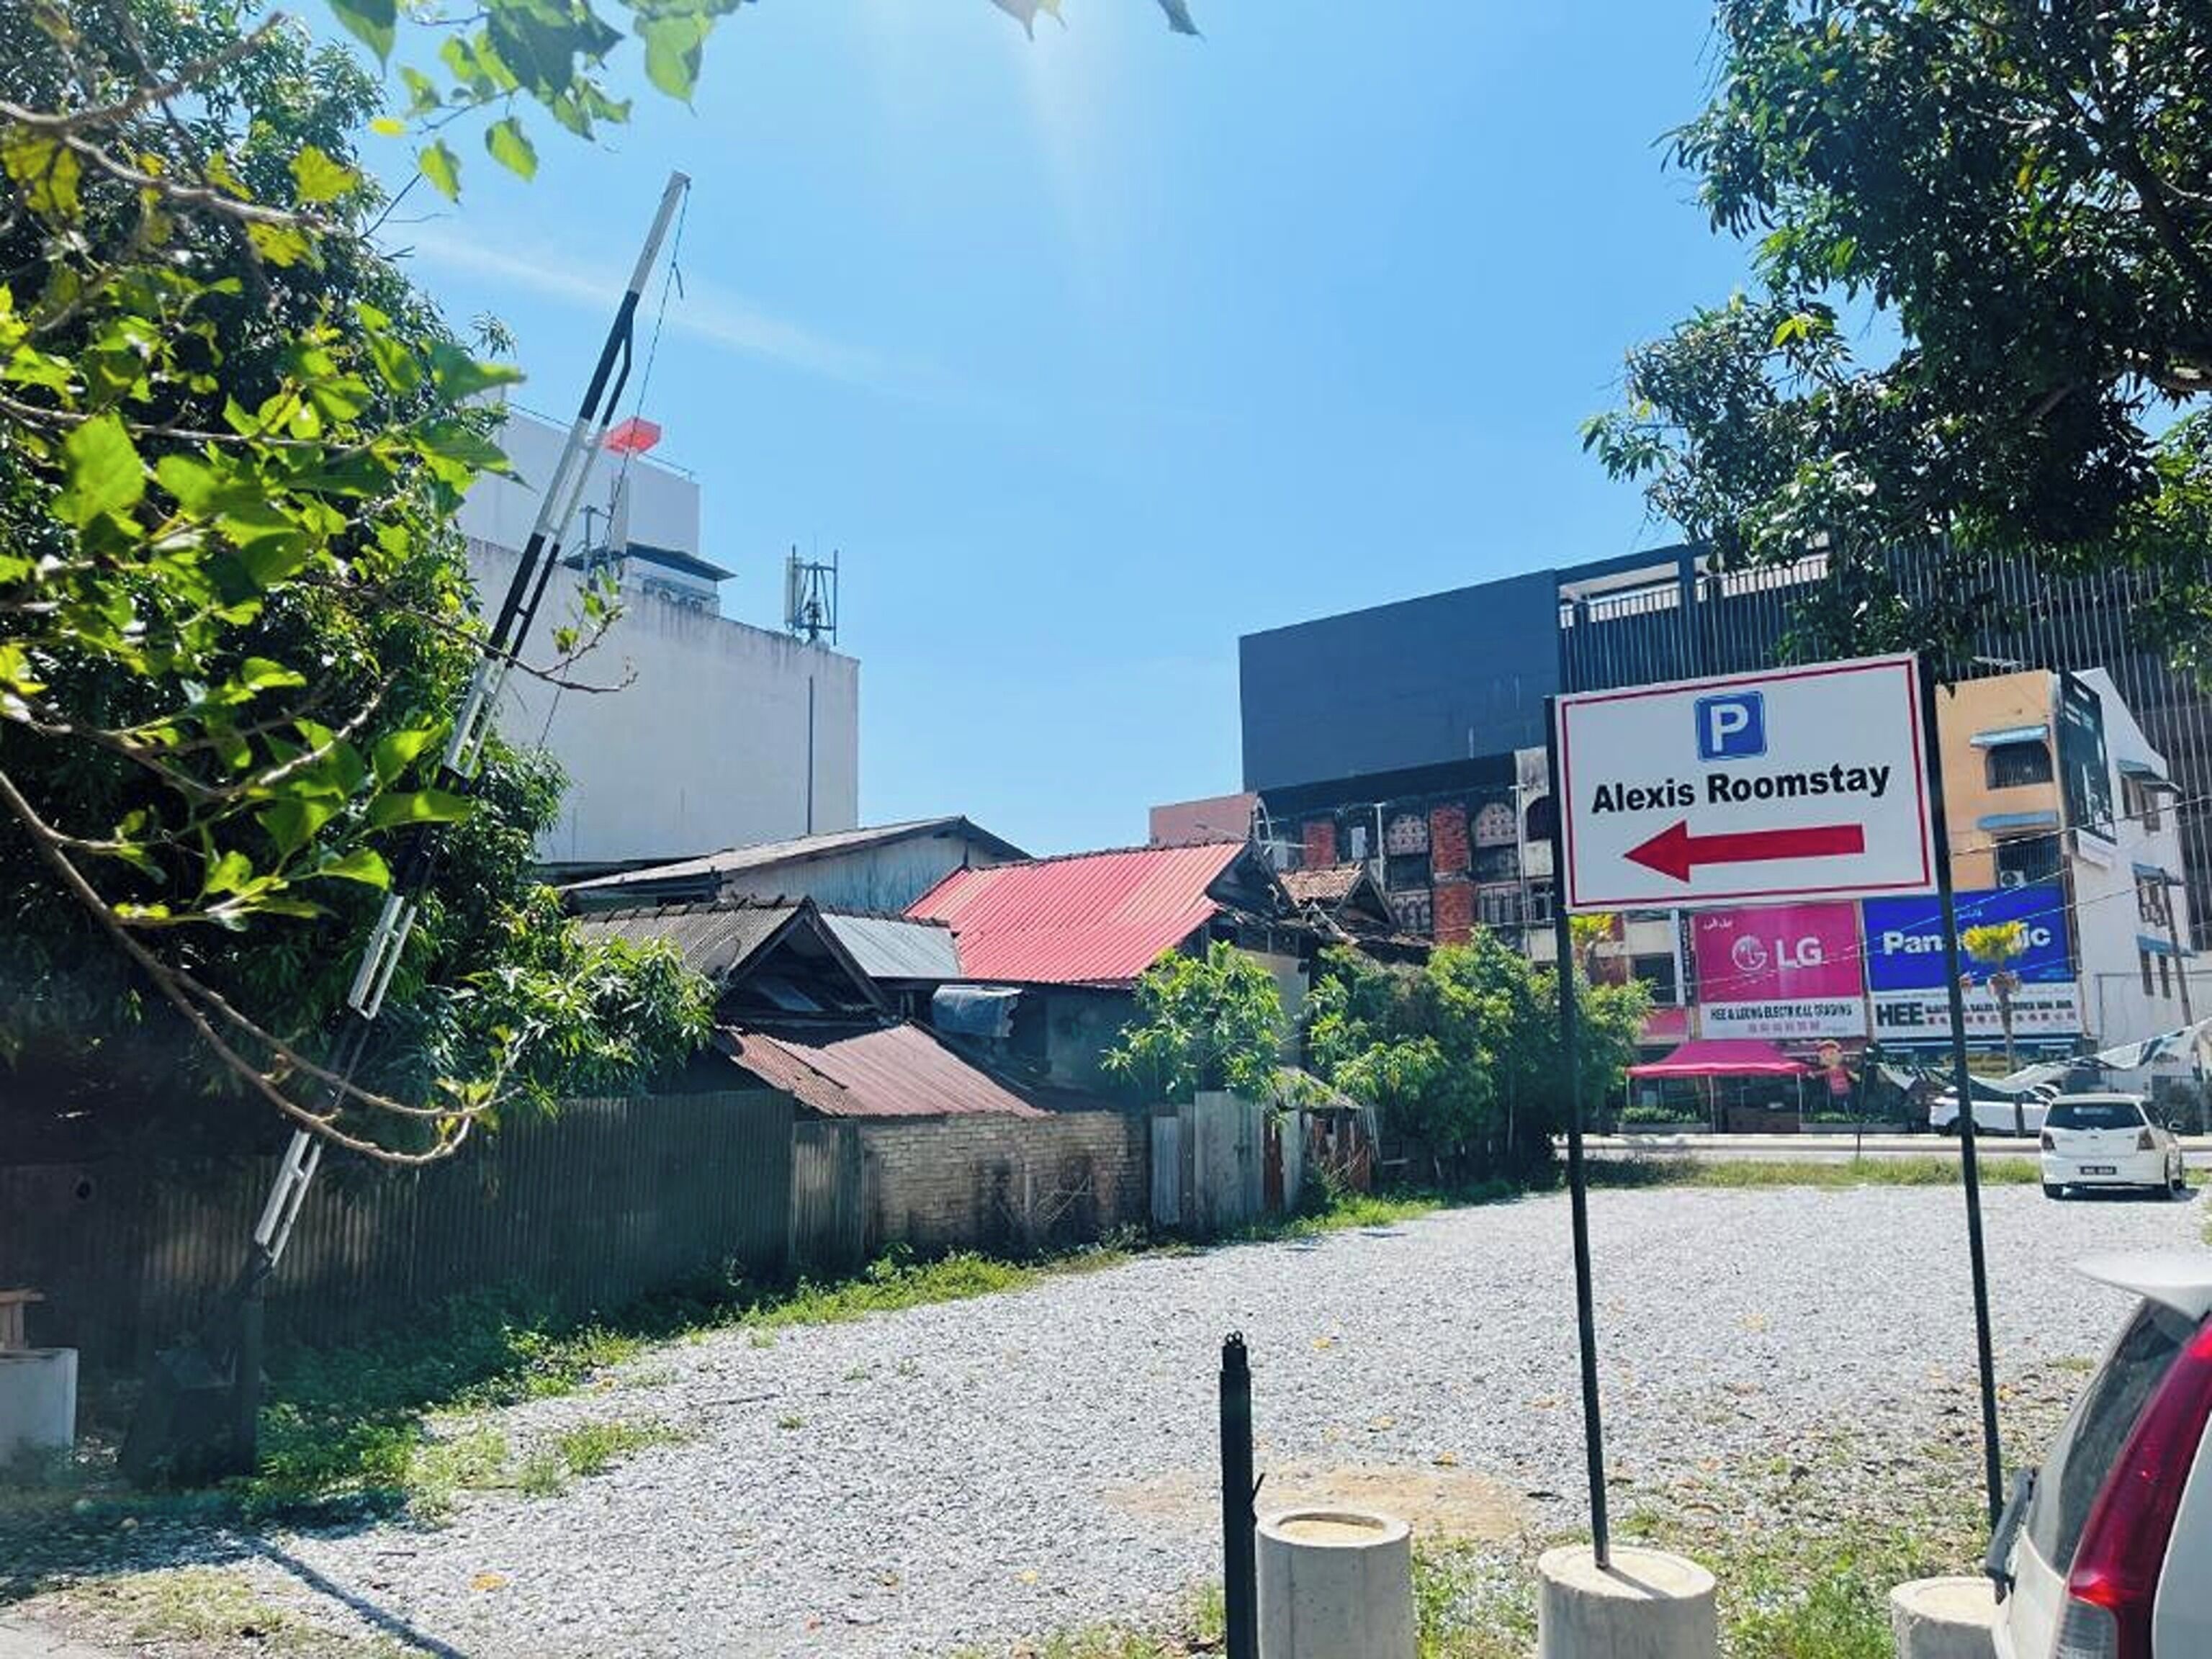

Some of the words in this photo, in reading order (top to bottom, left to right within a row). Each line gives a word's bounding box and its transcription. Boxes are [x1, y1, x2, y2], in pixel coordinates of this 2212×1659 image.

[1709, 703, 1749, 752] P
[1591, 778, 1695, 814] Alexis
[1707, 763, 1892, 804] Roomstay
[1775, 936, 1823, 968] LG
[1883, 922, 2051, 956] Panic
[1876, 1002, 1925, 1027] HEE
